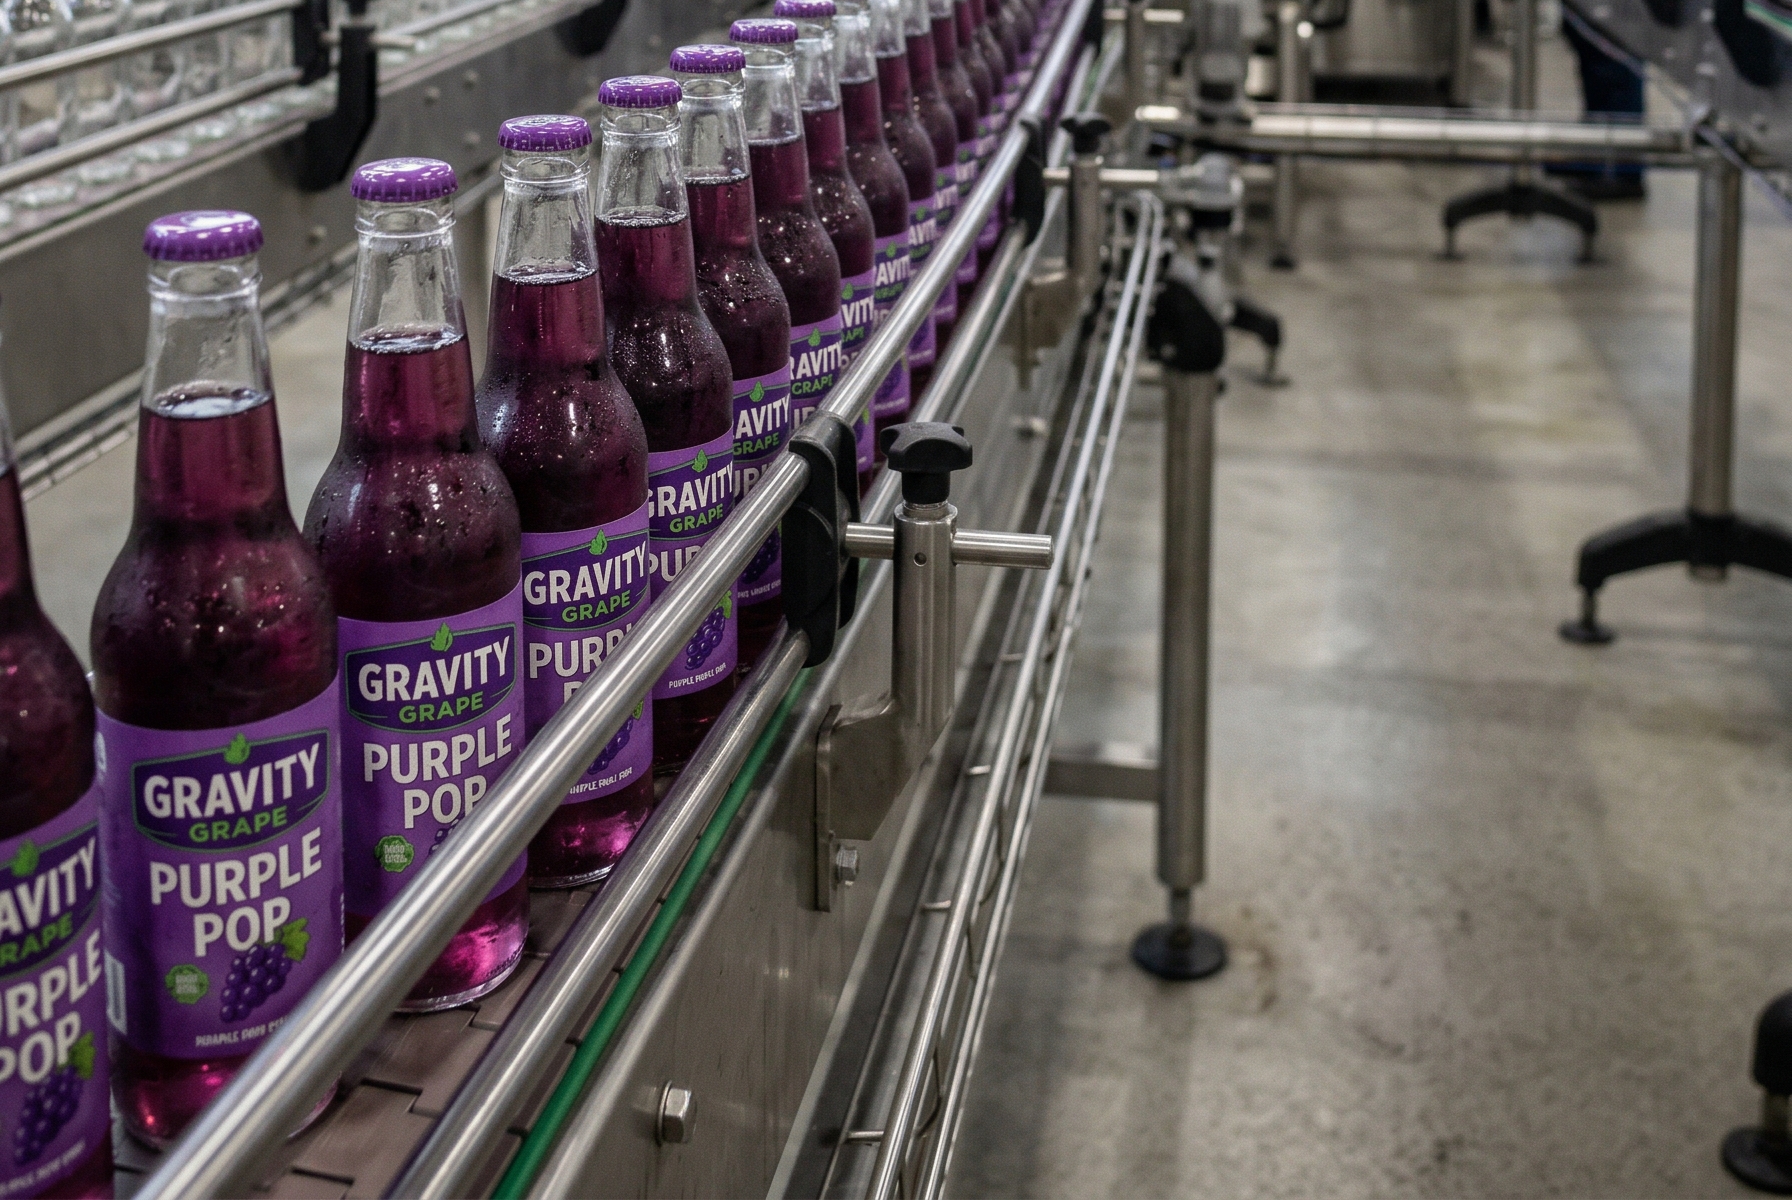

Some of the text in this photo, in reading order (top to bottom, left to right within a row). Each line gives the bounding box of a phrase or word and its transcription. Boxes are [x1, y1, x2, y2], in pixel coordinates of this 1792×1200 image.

[733, 432, 780, 456] GRAPE
[734, 392, 790, 439] AVITY
[669, 503, 724, 533] GRAPE
[524, 540, 646, 605] GRAVITY
[562, 589, 631, 623] GRAPE
[358, 635, 511, 702] GRAVITY
[399, 691, 484, 724] GRAPE
[363, 712, 513, 785] PURPLE
[144, 742, 320, 819] GRAVITY
[403, 774, 488, 829] POP
[188, 805, 288, 843] GRAPE
[0, 835, 96, 940] AVITY
[150, 826, 322, 908] PURPLE
[0, 911, 73, 968] RAPE
[193, 896, 291, 957] POP
[0, 929, 102, 1037] RPLE
